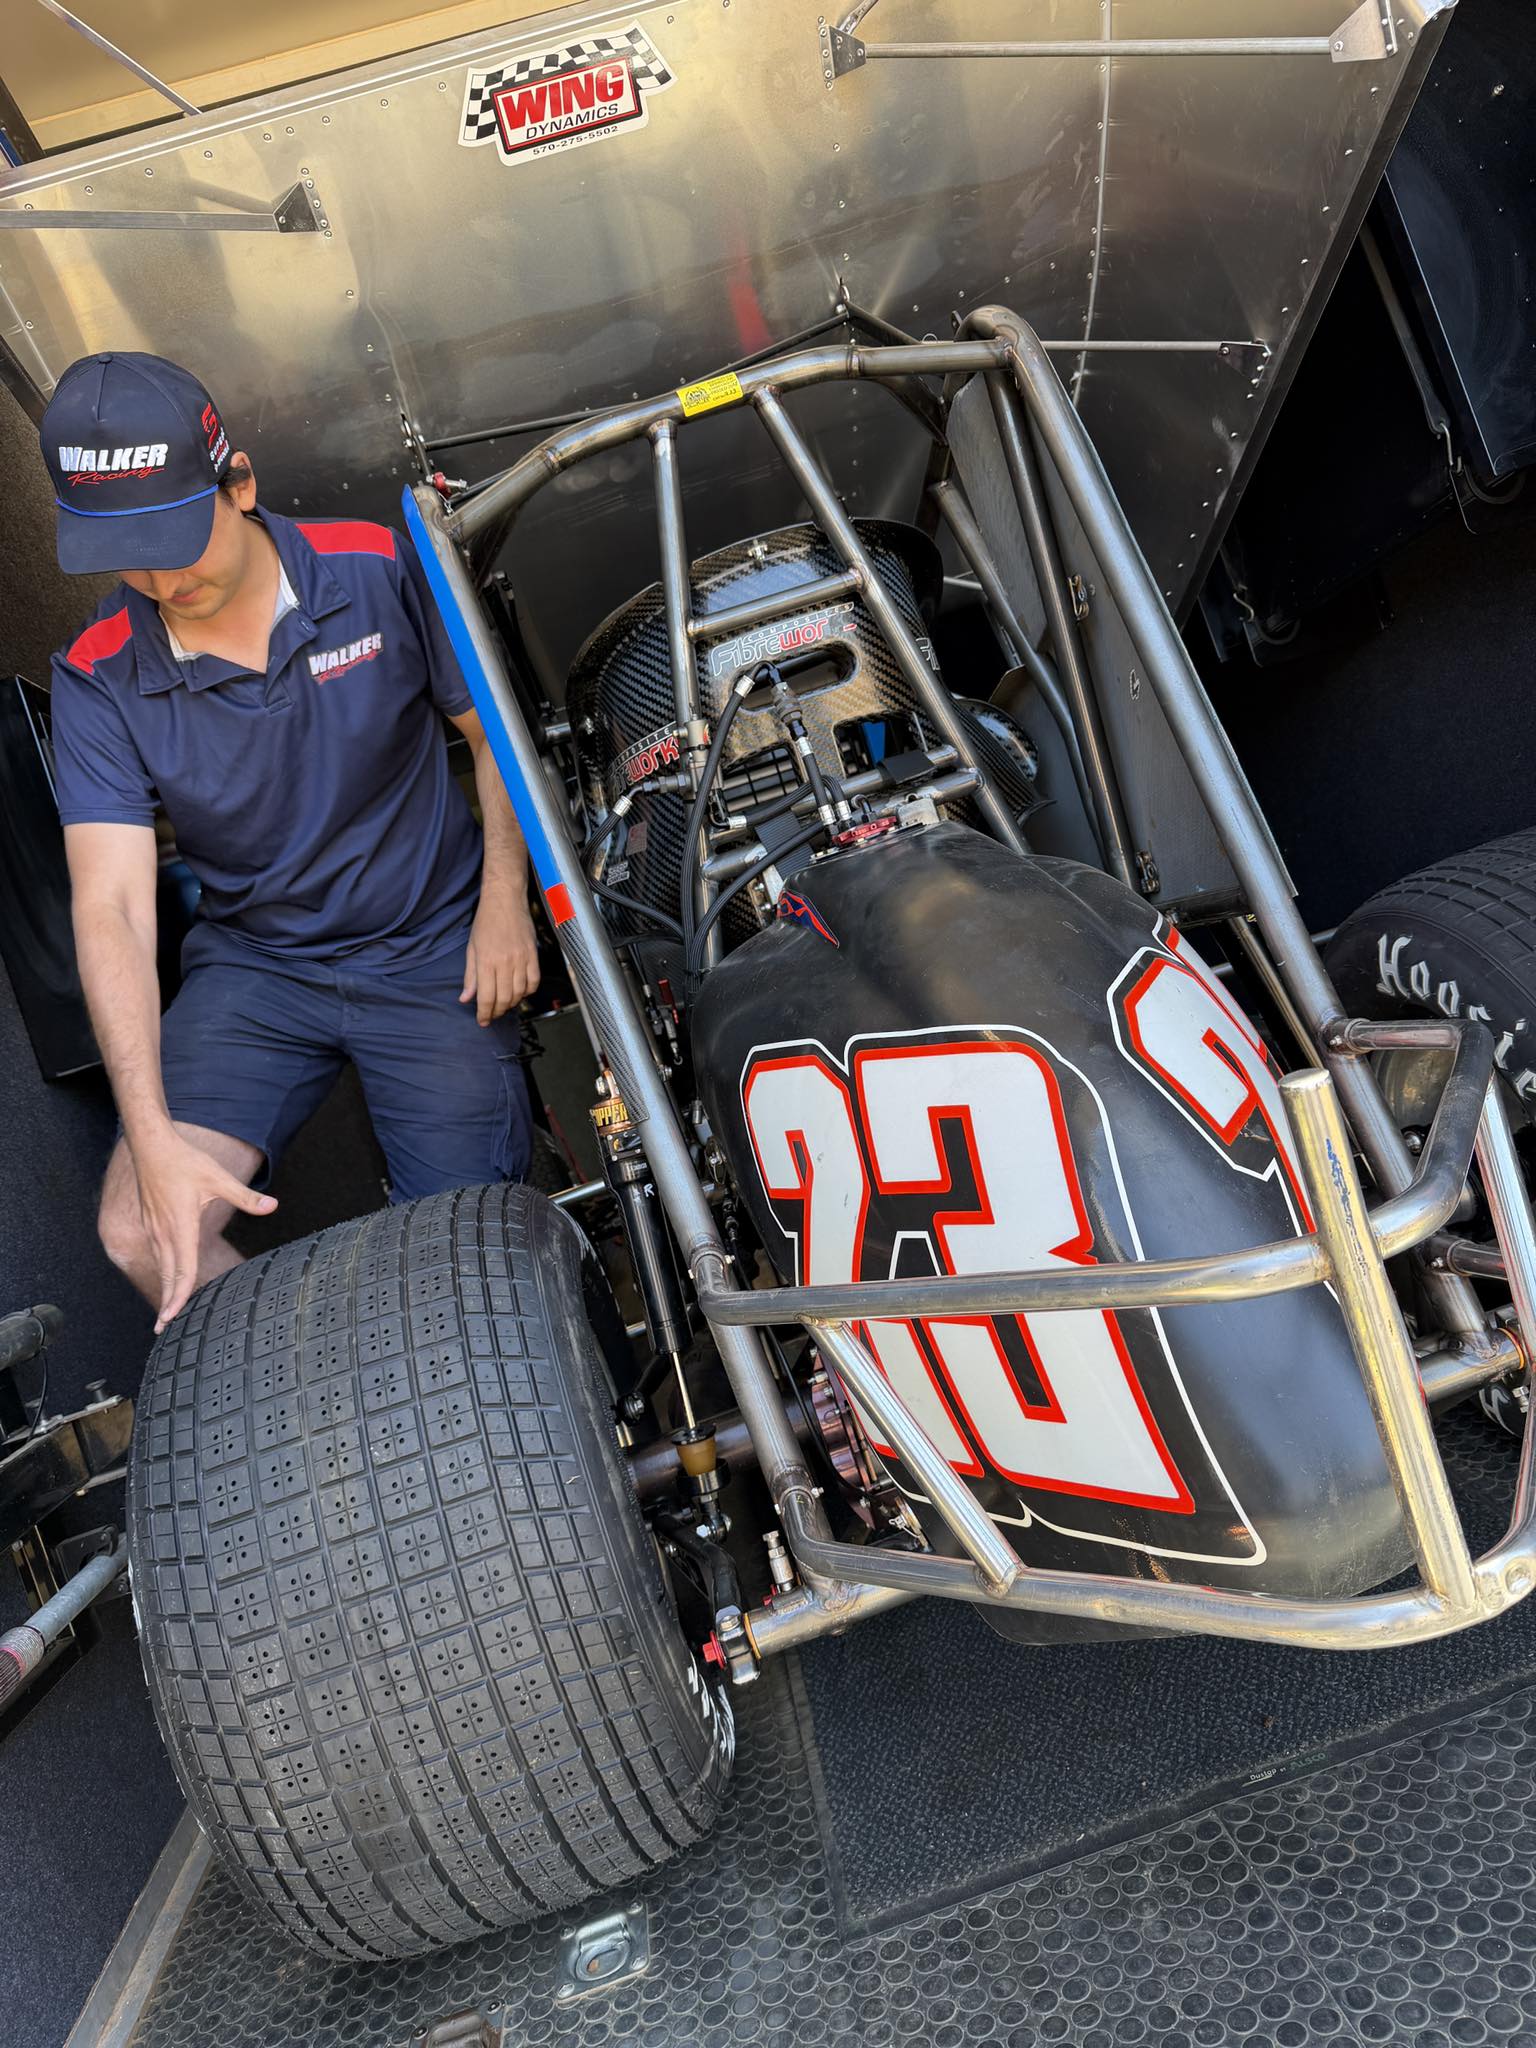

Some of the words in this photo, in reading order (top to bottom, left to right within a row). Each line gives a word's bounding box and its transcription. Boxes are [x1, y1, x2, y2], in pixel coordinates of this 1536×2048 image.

[503, 65, 623, 130] WING
[526, 103, 618, 139] DYNAMICS
[533, 125, 618, 155] 570-275-5502
[58, 443, 169, 472] WALKER
[67, 465, 165, 487] Racing
[308, 632, 382, 676] WALKER
[711, 619, 857, 677] Fibrewor
[743, 1040, 1196, 1515] 23
